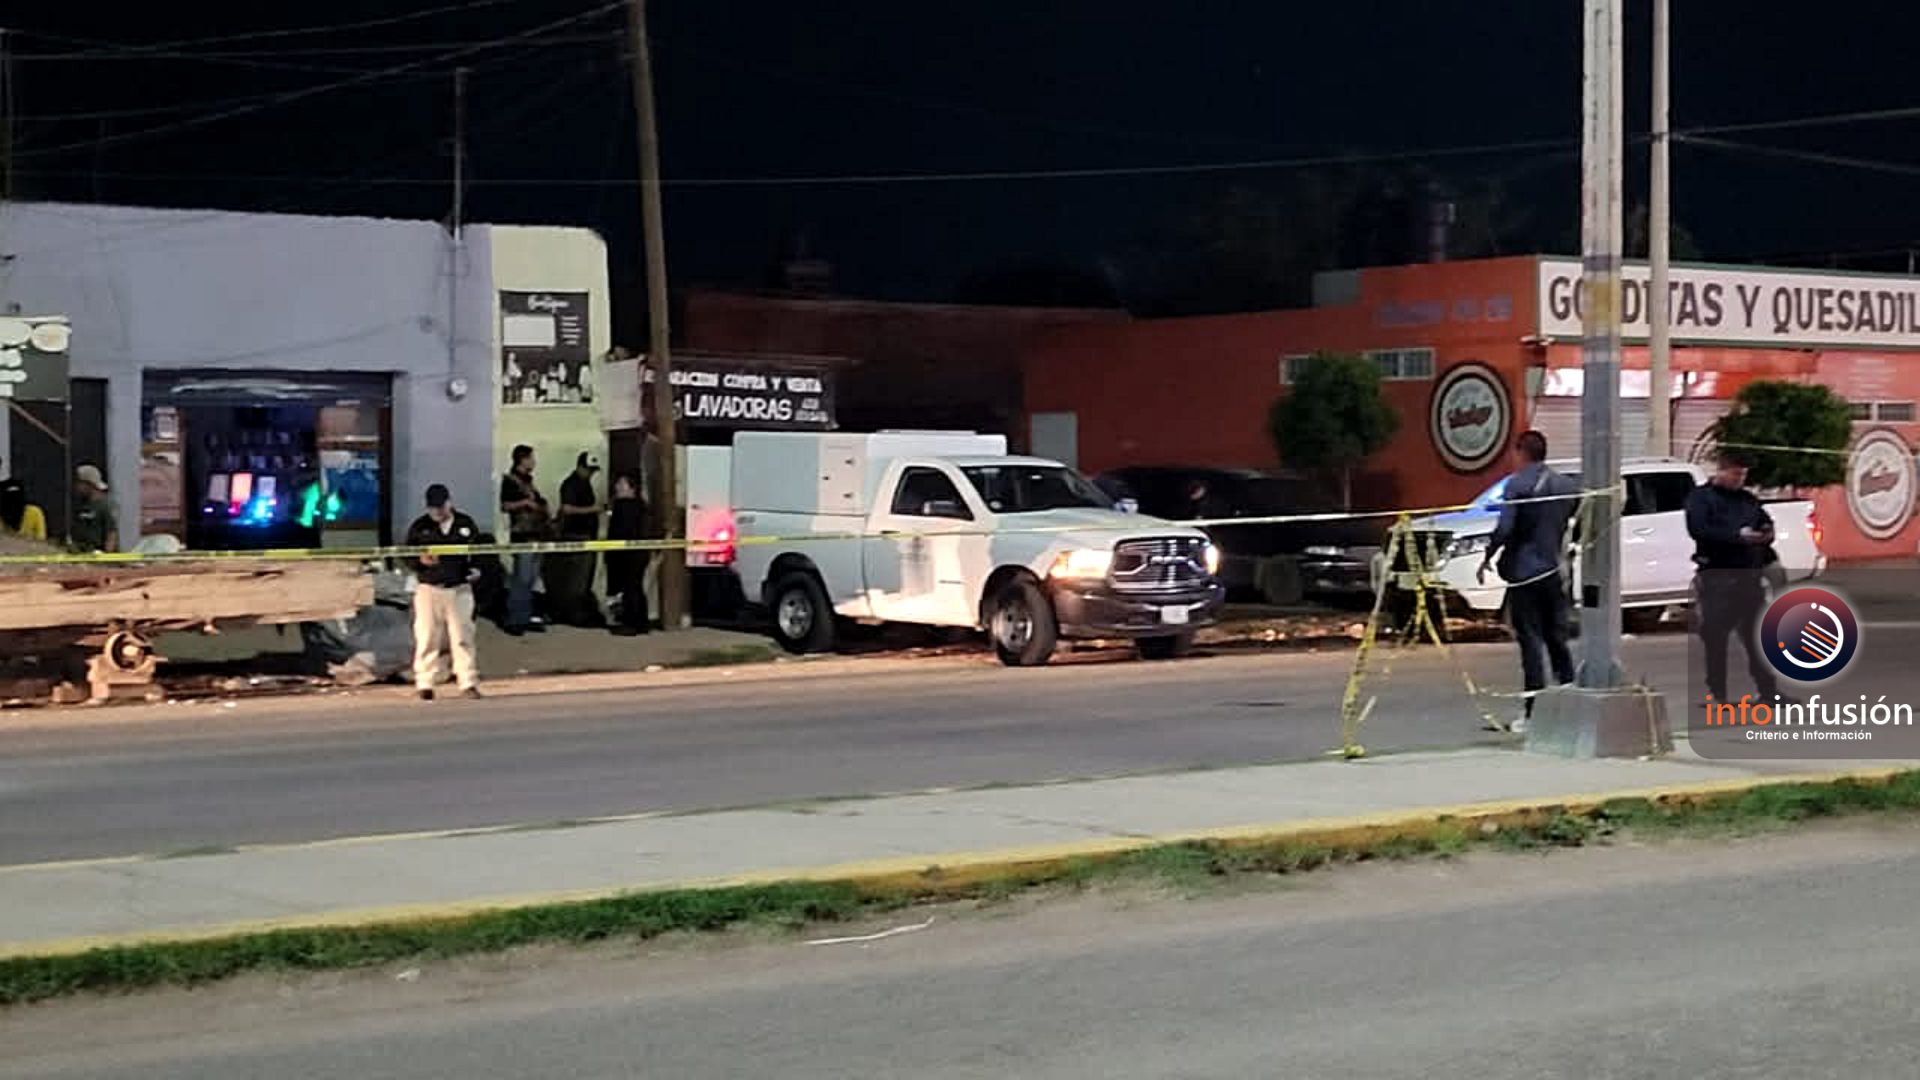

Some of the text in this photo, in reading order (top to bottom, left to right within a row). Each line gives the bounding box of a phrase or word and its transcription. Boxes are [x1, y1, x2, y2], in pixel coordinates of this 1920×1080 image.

[1736, 285, 1762, 328] Y
[1773, 287, 1920, 334] QUESADIL
[770, 377, 781, 391] Y
[684, 393, 792, 420] LAVADORAS
